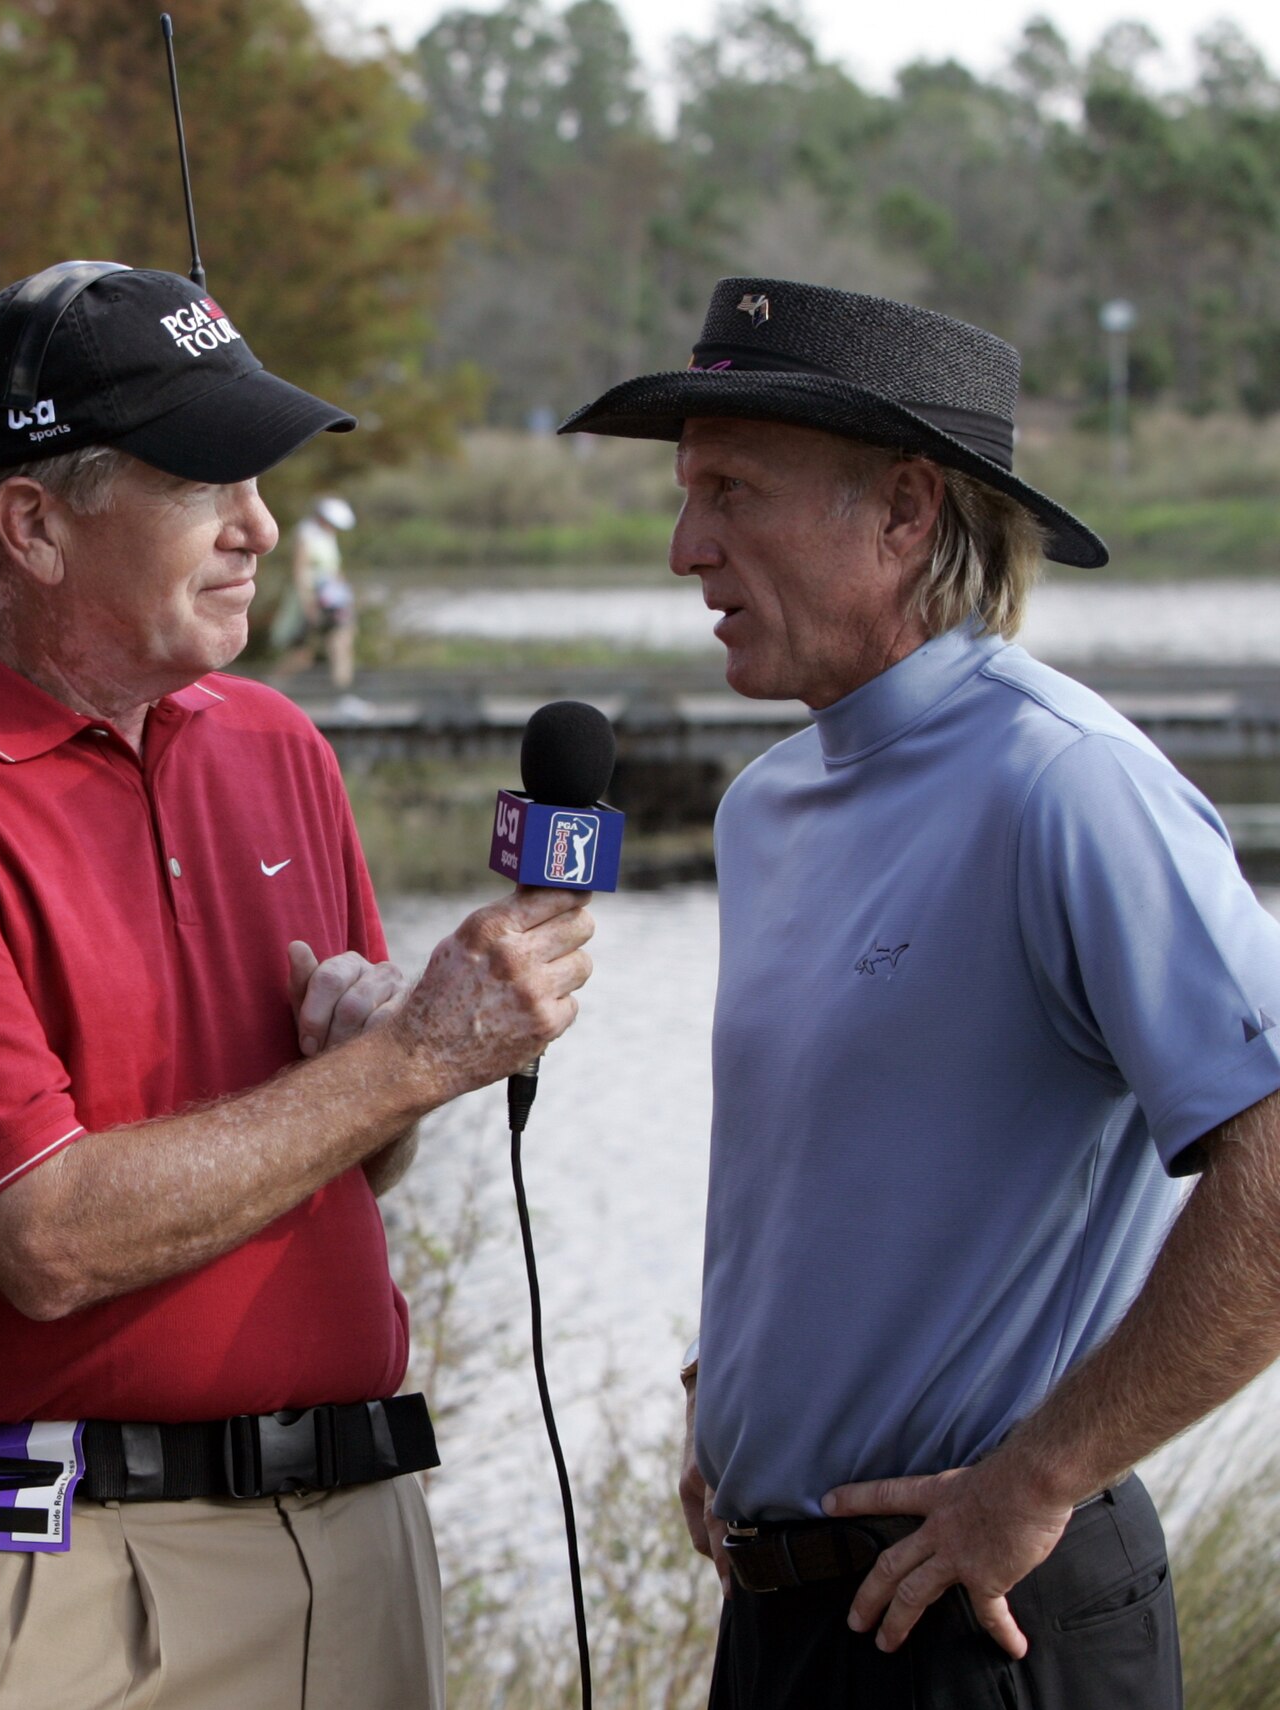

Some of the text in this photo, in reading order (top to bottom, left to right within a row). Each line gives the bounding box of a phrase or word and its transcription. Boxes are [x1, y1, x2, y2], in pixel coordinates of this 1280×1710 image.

[160, 302, 211, 339] PGA
[176, 317, 240, 357] TOUR
[29, 424, 71, 442] sports
[557, 821, 578, 831] PGA
[501, 849, 518, 870] sports
[550, 829, 570, 878] TOUR
[54, 1481, 66, 1506] Ropes
[52, 1510, 61, 1536] Inside
